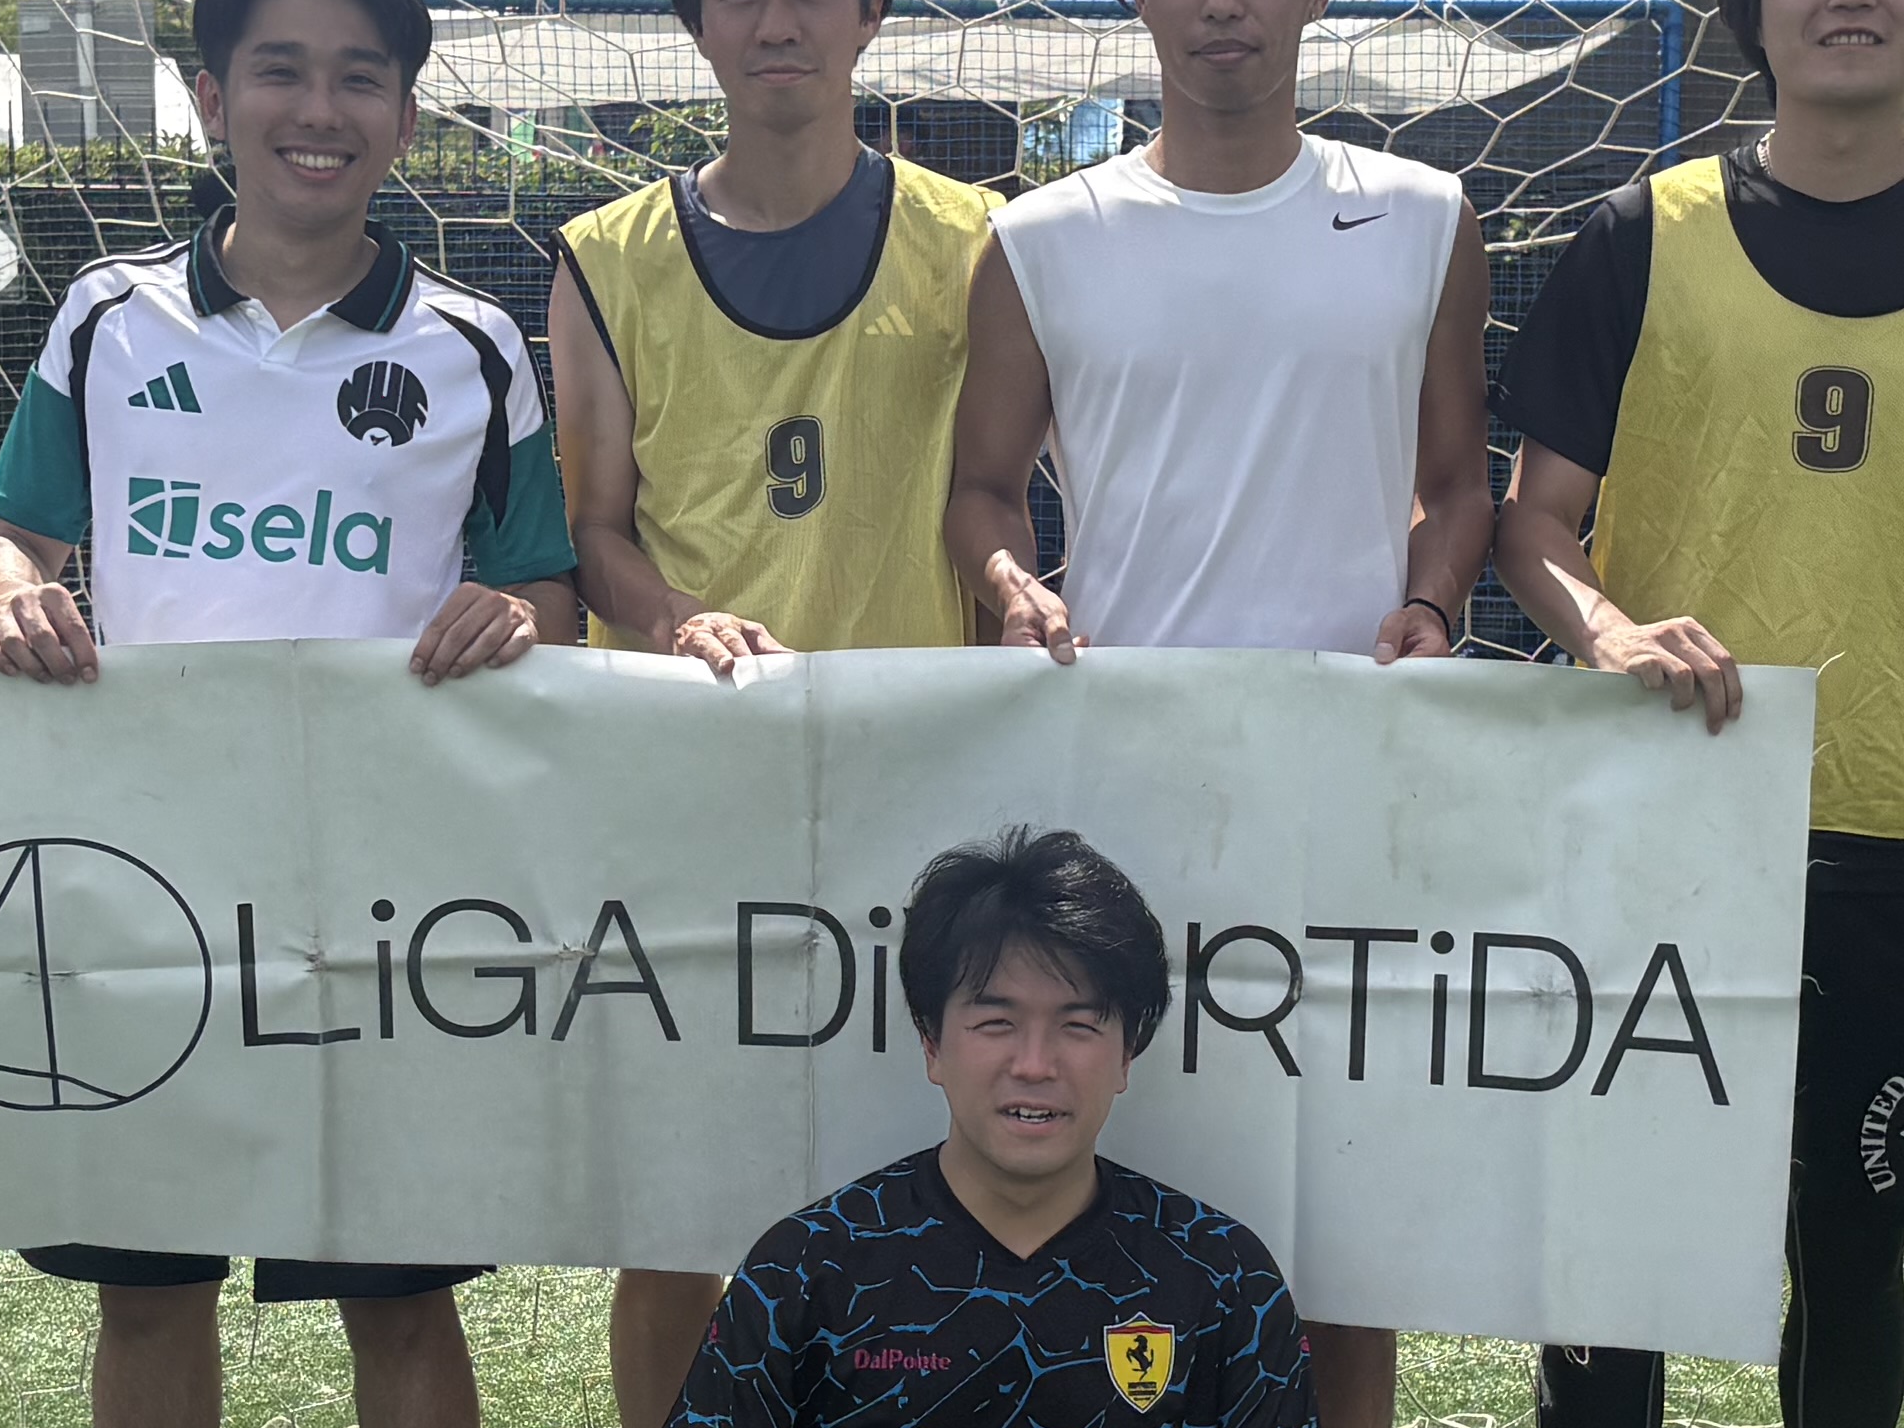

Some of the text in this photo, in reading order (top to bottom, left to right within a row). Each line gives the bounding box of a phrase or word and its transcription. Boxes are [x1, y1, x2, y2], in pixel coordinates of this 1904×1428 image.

[764, 415, 827, 520] 9
[1792, 365, 1875, 474] 9
[201, 488, 393, 576] sela
[736, 901, 1731, 1107] DiRTiDA
